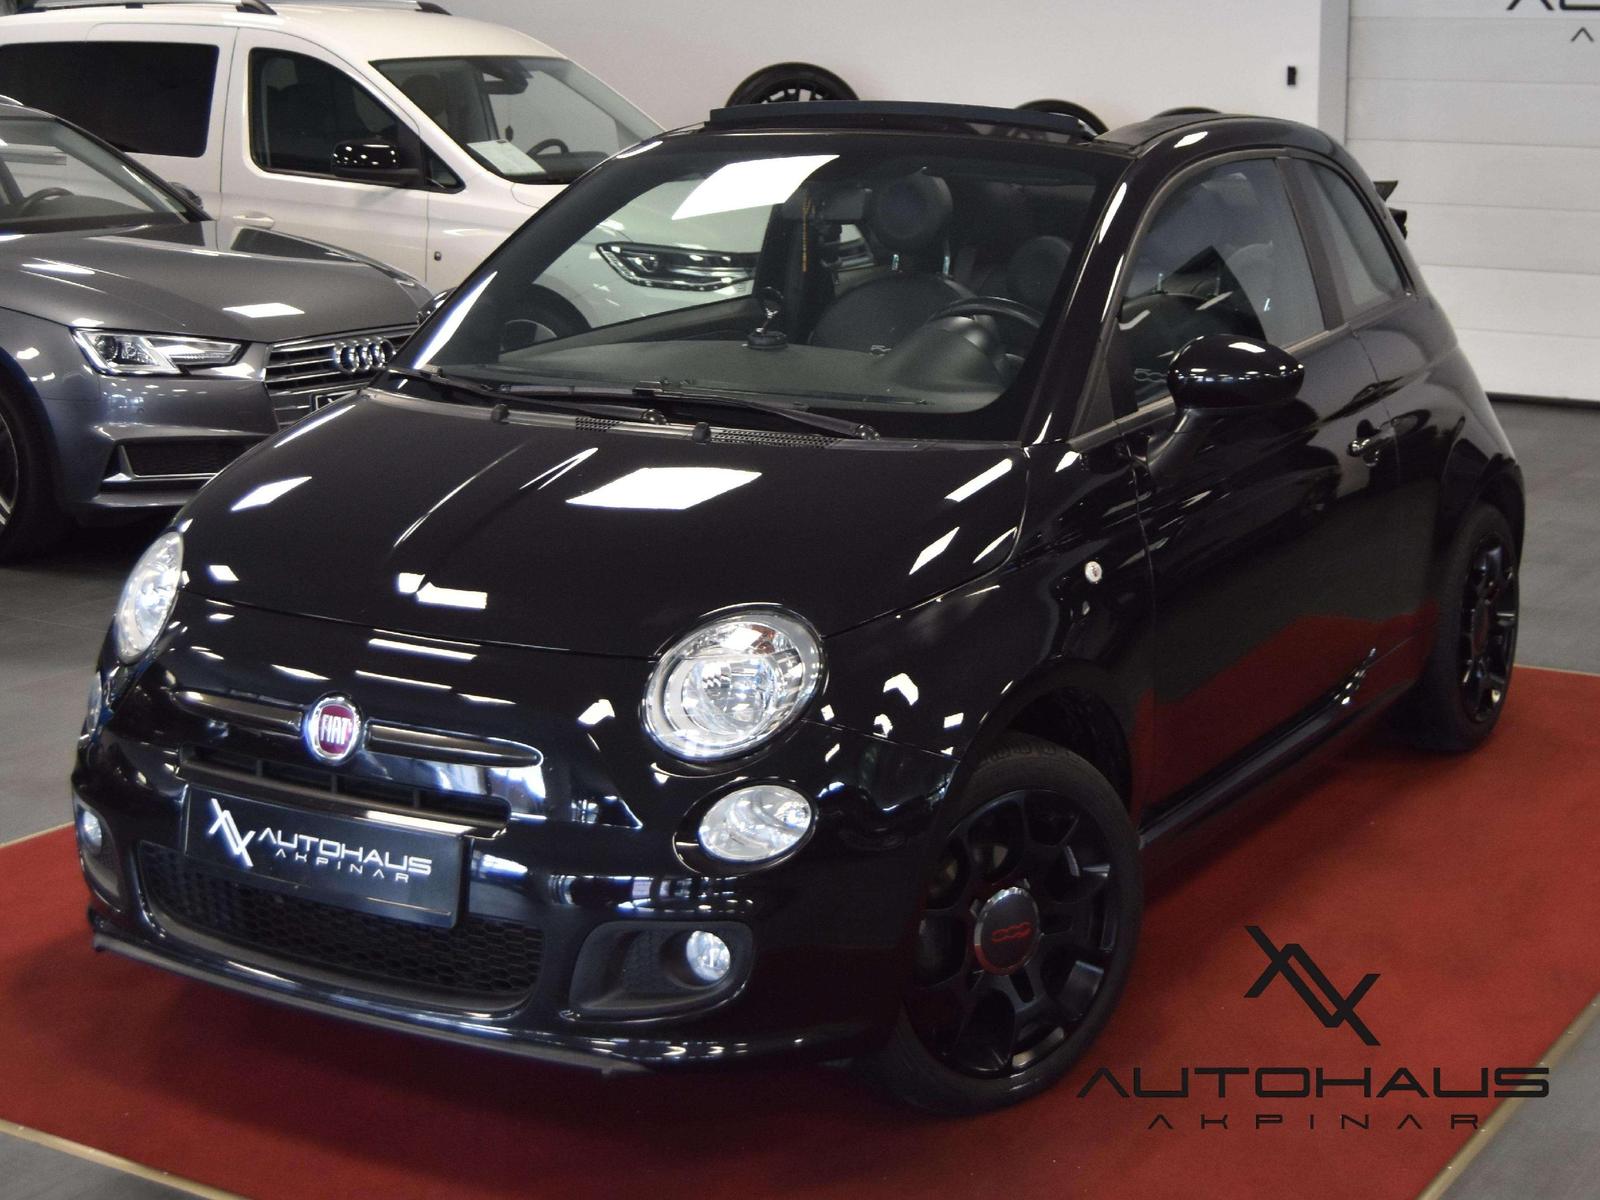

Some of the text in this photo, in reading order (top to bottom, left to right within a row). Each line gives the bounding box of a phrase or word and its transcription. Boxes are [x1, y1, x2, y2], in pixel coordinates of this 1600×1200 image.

[320, 713, 351, 746] FIAT
[258, 827, 432, 876] AUTOHAUS
[275, 849, 410, 883] AKPINAR
